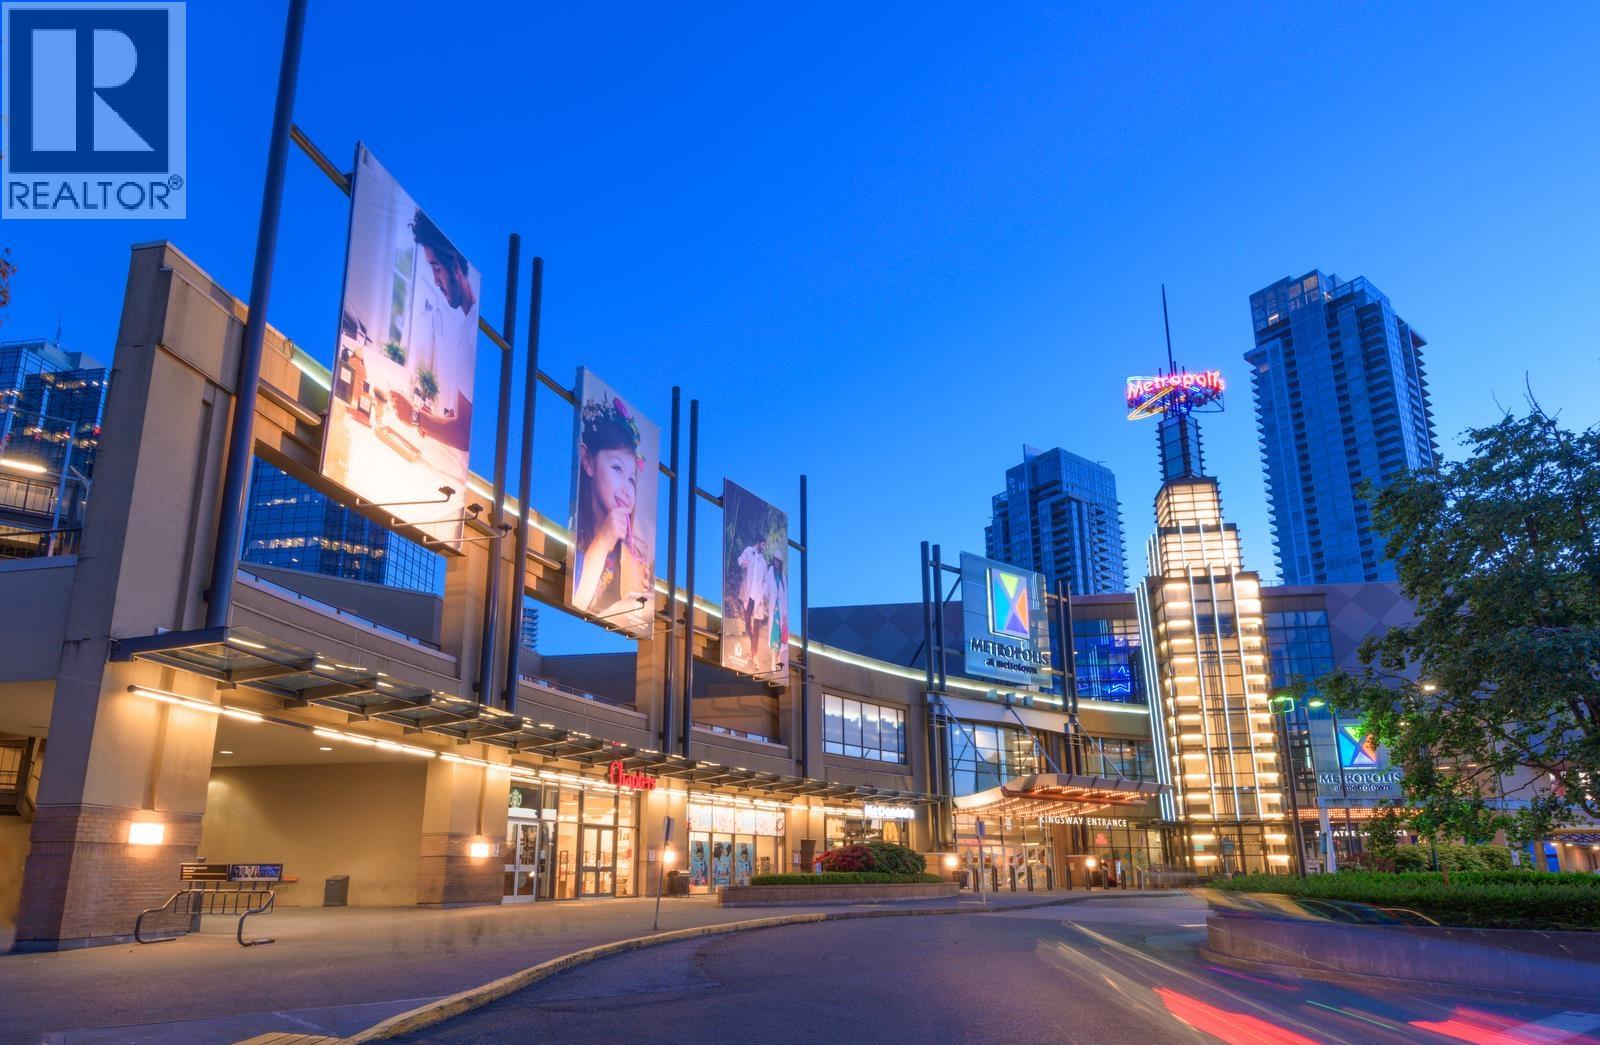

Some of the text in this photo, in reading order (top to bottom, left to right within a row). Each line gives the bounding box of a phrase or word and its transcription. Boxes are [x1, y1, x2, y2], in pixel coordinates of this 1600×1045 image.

[1126, 370, 1226, 400] Metropolis
[969, 637, 1048, 667] METROPOLIS
[985, 658, 1038, 675] at metrotown
[608, 760, 657, 791] Chapters
[1346, 784, 1391, 792] metrotown
[1039, 814, 1127, 828] KINGSWAY ENTRANCE
